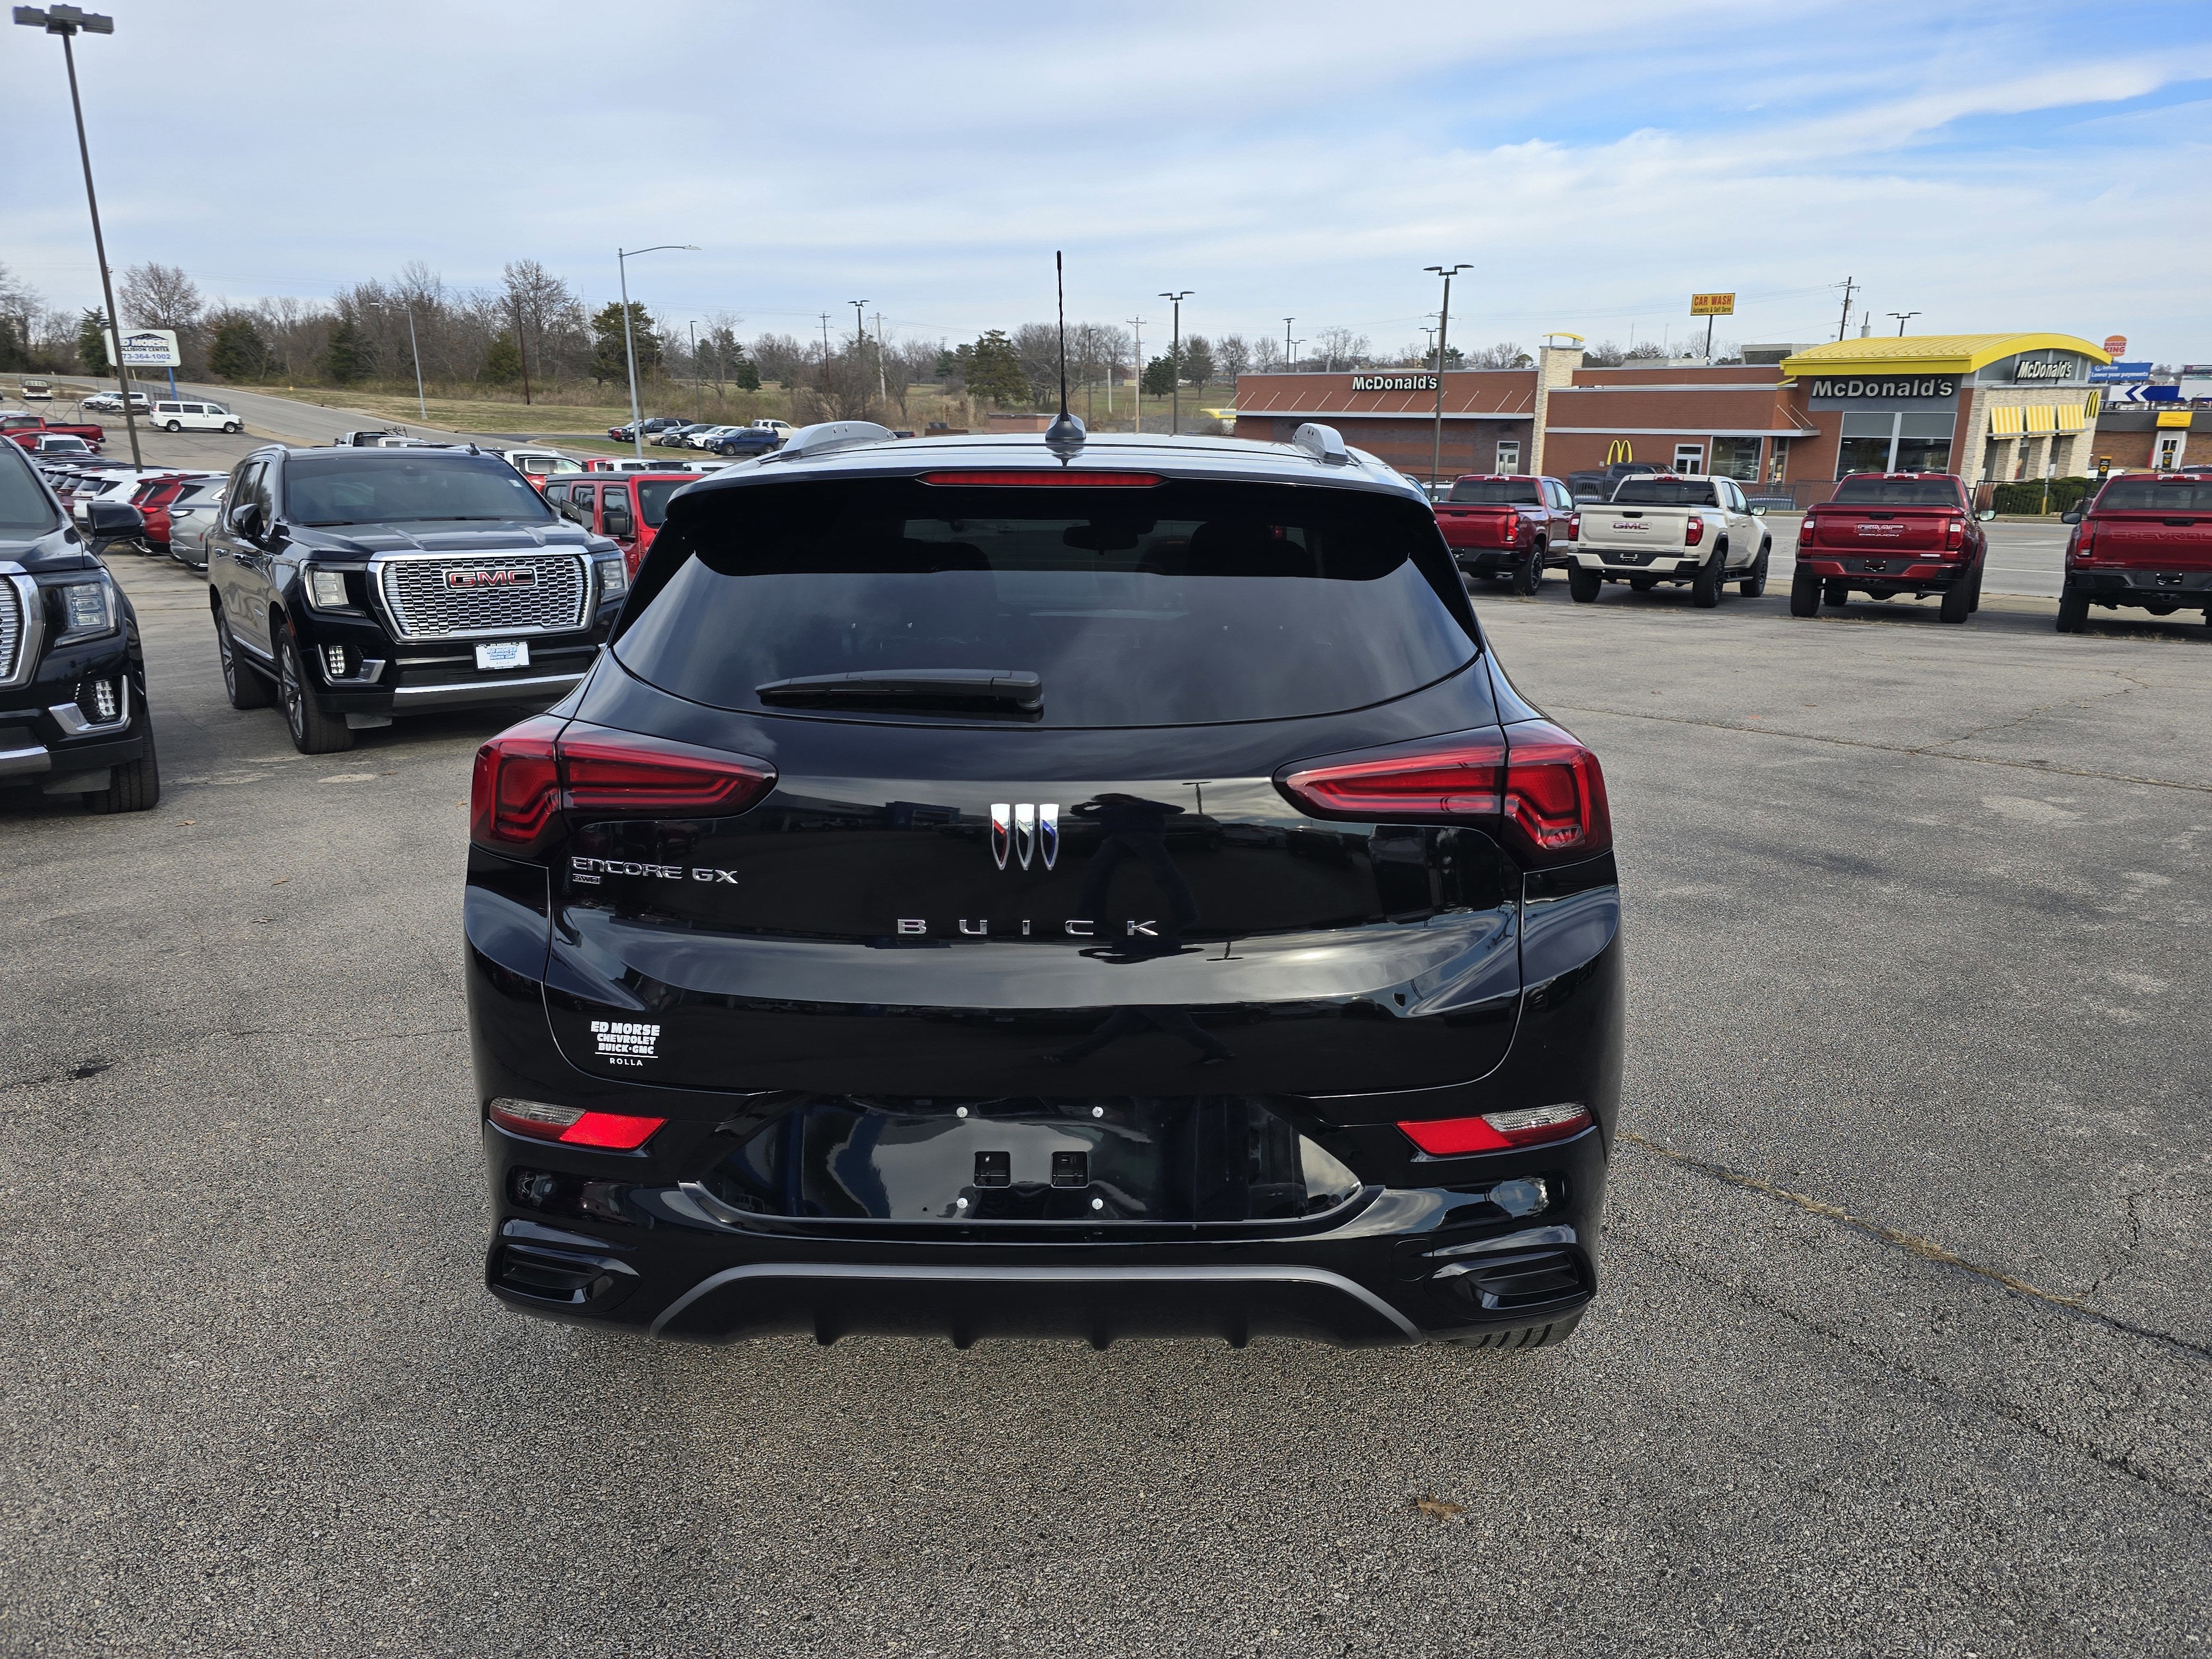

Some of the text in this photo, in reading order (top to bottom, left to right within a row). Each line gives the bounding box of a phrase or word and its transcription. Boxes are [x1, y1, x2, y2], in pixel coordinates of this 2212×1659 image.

[1694, 295, 1731, 306] CAR WASH
[132, 338, 169, 347] MORSE
[2017, 361, 2073, 378] McDonald's
[1353, 375, 1437, 390] McDonald's
[1812, 379, 1953, 397] McDonald's
[1857, 524, 1904, 533] GMC
[448, 570, 534, 588] GMC
[571, 857, 738, 884] ENCORE GX
[898, 919, 1159, 936] BUICK
[591, 1021, 660, 1036] ED MORSE
[597, 1034, 656, 1045] CHEVROLET
[609, 1057, 643, 1066] ROLLA
